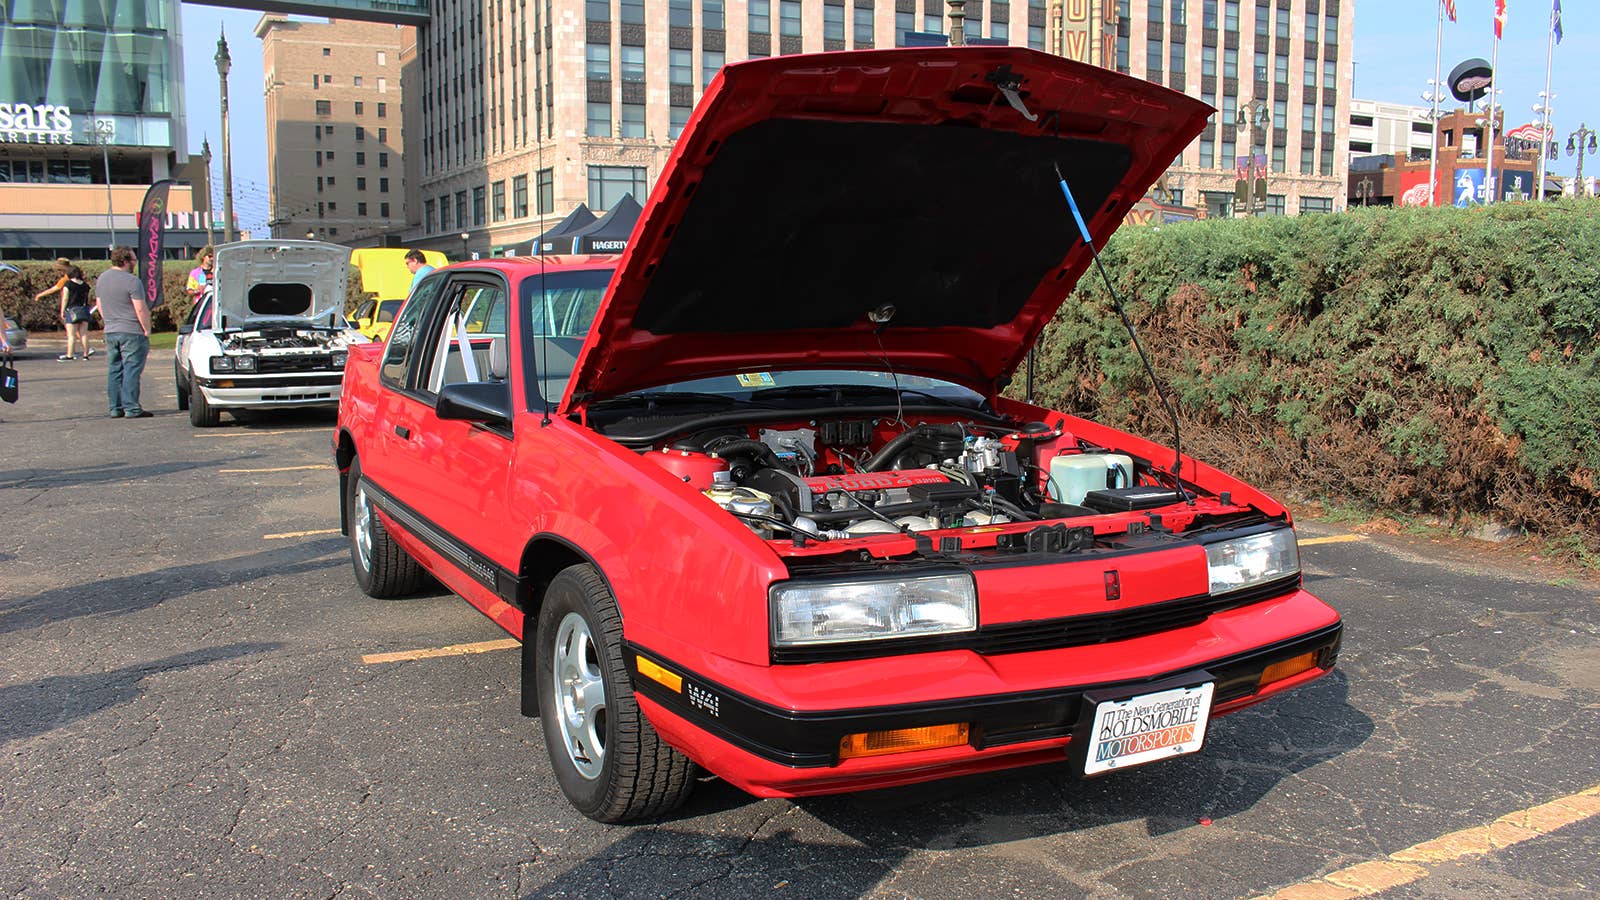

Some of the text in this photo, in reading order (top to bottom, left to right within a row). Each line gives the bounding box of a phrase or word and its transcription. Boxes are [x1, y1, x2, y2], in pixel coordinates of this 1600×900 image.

[148, 216, 159, 302] RADWOOD
[592, 241, 628, 250] HAGERTY
[688, 683, 719, 717] W41
[1117, 694, 1202, 720] The New Generation of
[1112, 705, 1200, 738] OLDSMOBILE
[1096, 726, 1194, 762] MOTORSPORTS
